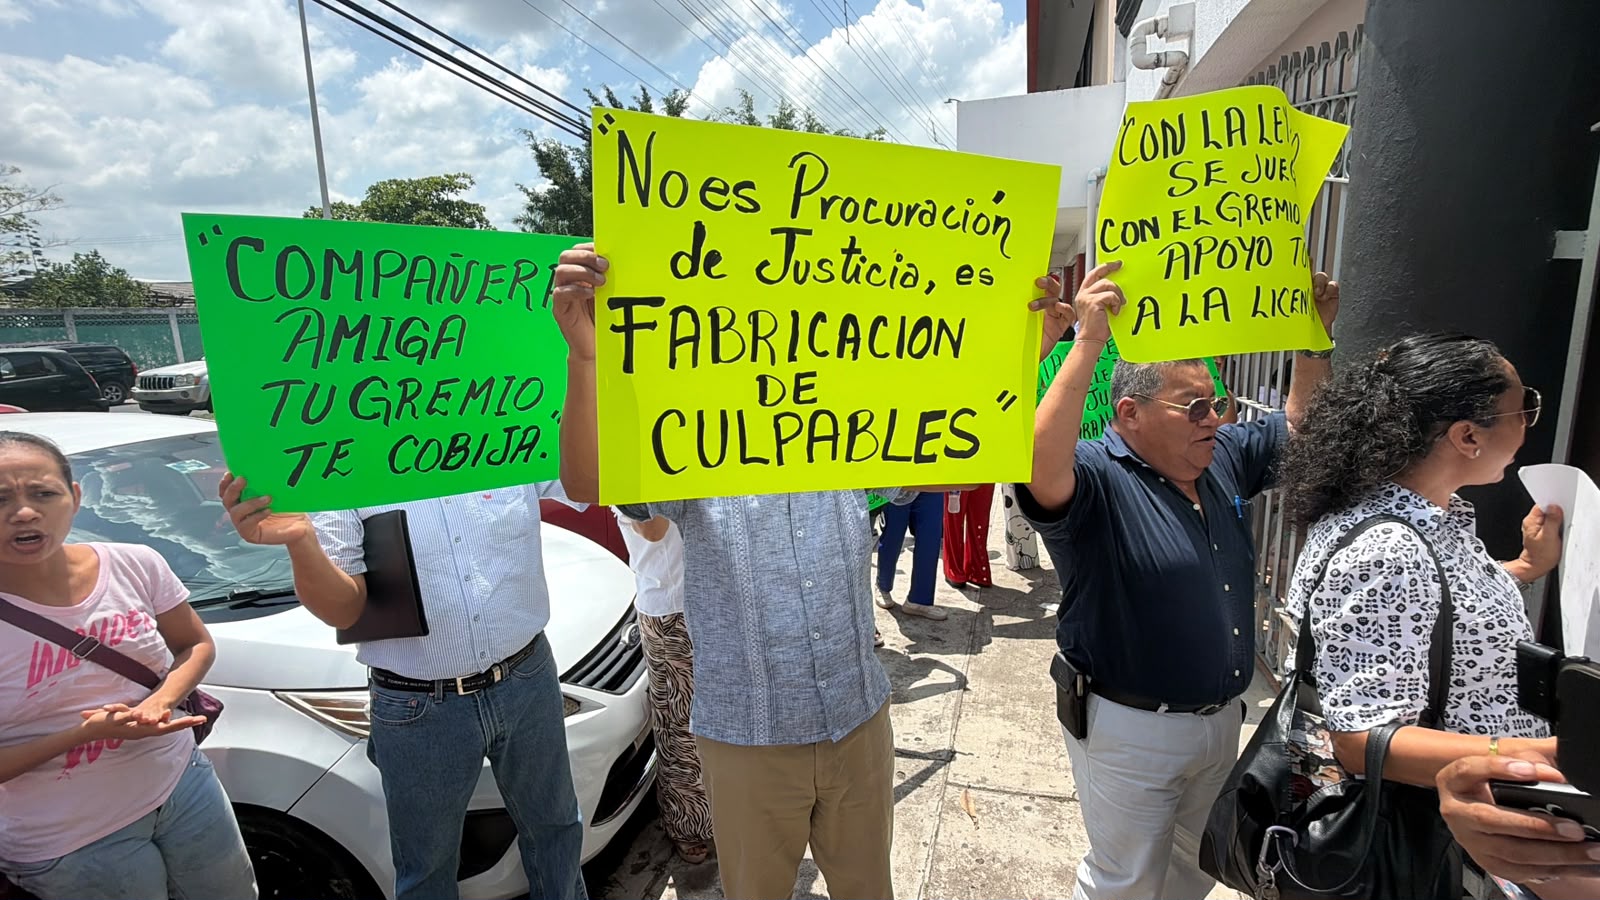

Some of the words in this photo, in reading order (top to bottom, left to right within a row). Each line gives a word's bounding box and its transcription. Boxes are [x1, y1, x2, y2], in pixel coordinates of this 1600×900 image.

[1202, 107, 1247, 149] LA
[1168, 161, 1227, 197] SE
[786, 152, 1011, 259] Procuración
[1100, 217, 1160, 252] CON
[1172, 206, 1212, 233] EL
[1216, 191, 1300, 228] GREMIO
[671, 221, 726, 279] de
[756, 227, 935, 294] Justicia,
[956, 265, 994, 285] es
[1158, 235, 1273, 280] APOYO
[607, 297, 965, 373] FABRICACION
[1132, 297, 1160, 335] A
[1180, 287, 1231, 326] LA
[275, 307, 467, 369] AMIGA
[262, 380, 337, 427] TU
[349, 376, 544, 424] GREMIO
[756, 371, 817, 406] DE
[284, 439, 355, 487] TE
